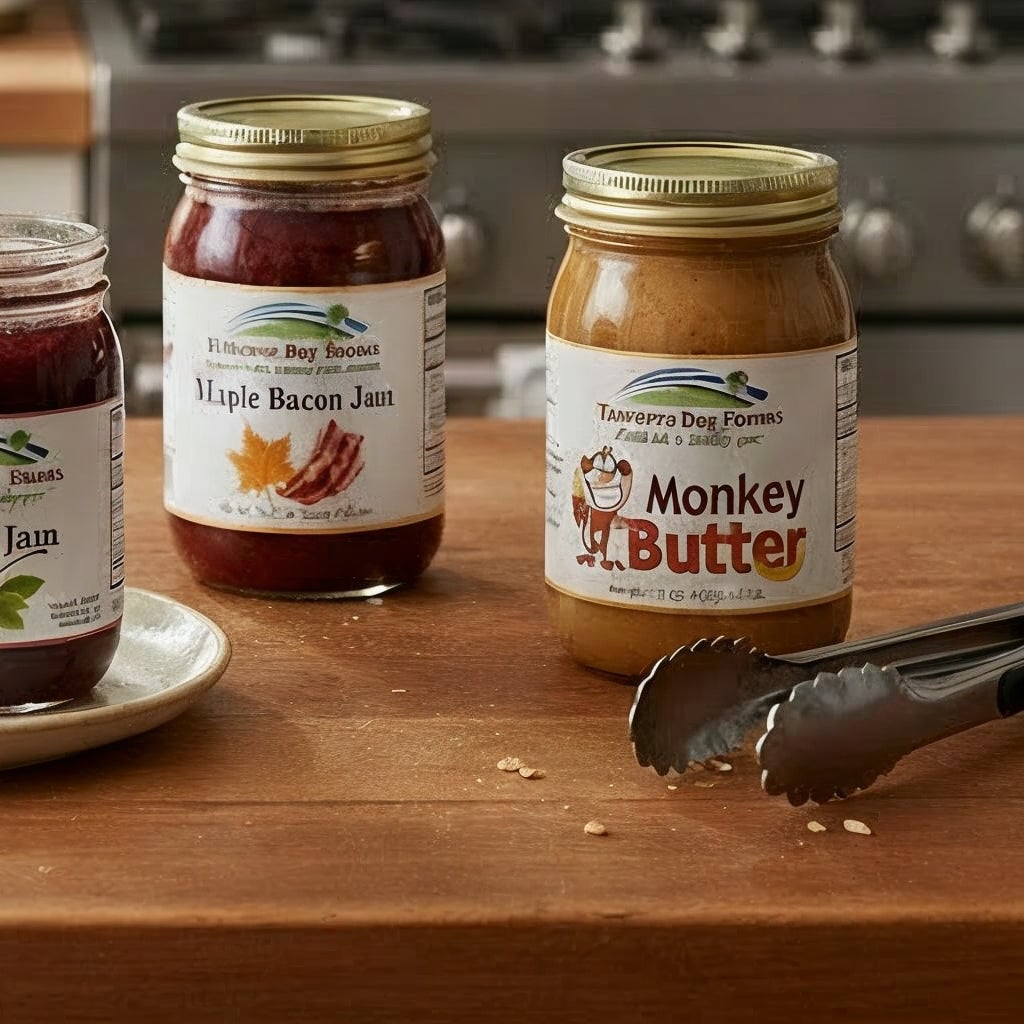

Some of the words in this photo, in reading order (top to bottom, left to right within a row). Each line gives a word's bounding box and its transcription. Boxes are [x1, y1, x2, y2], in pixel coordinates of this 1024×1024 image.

[268, 386, 342, 411] Bacon
[646, 473, 805, 520] Monkey
[628, 518, 807, 576] Butter
